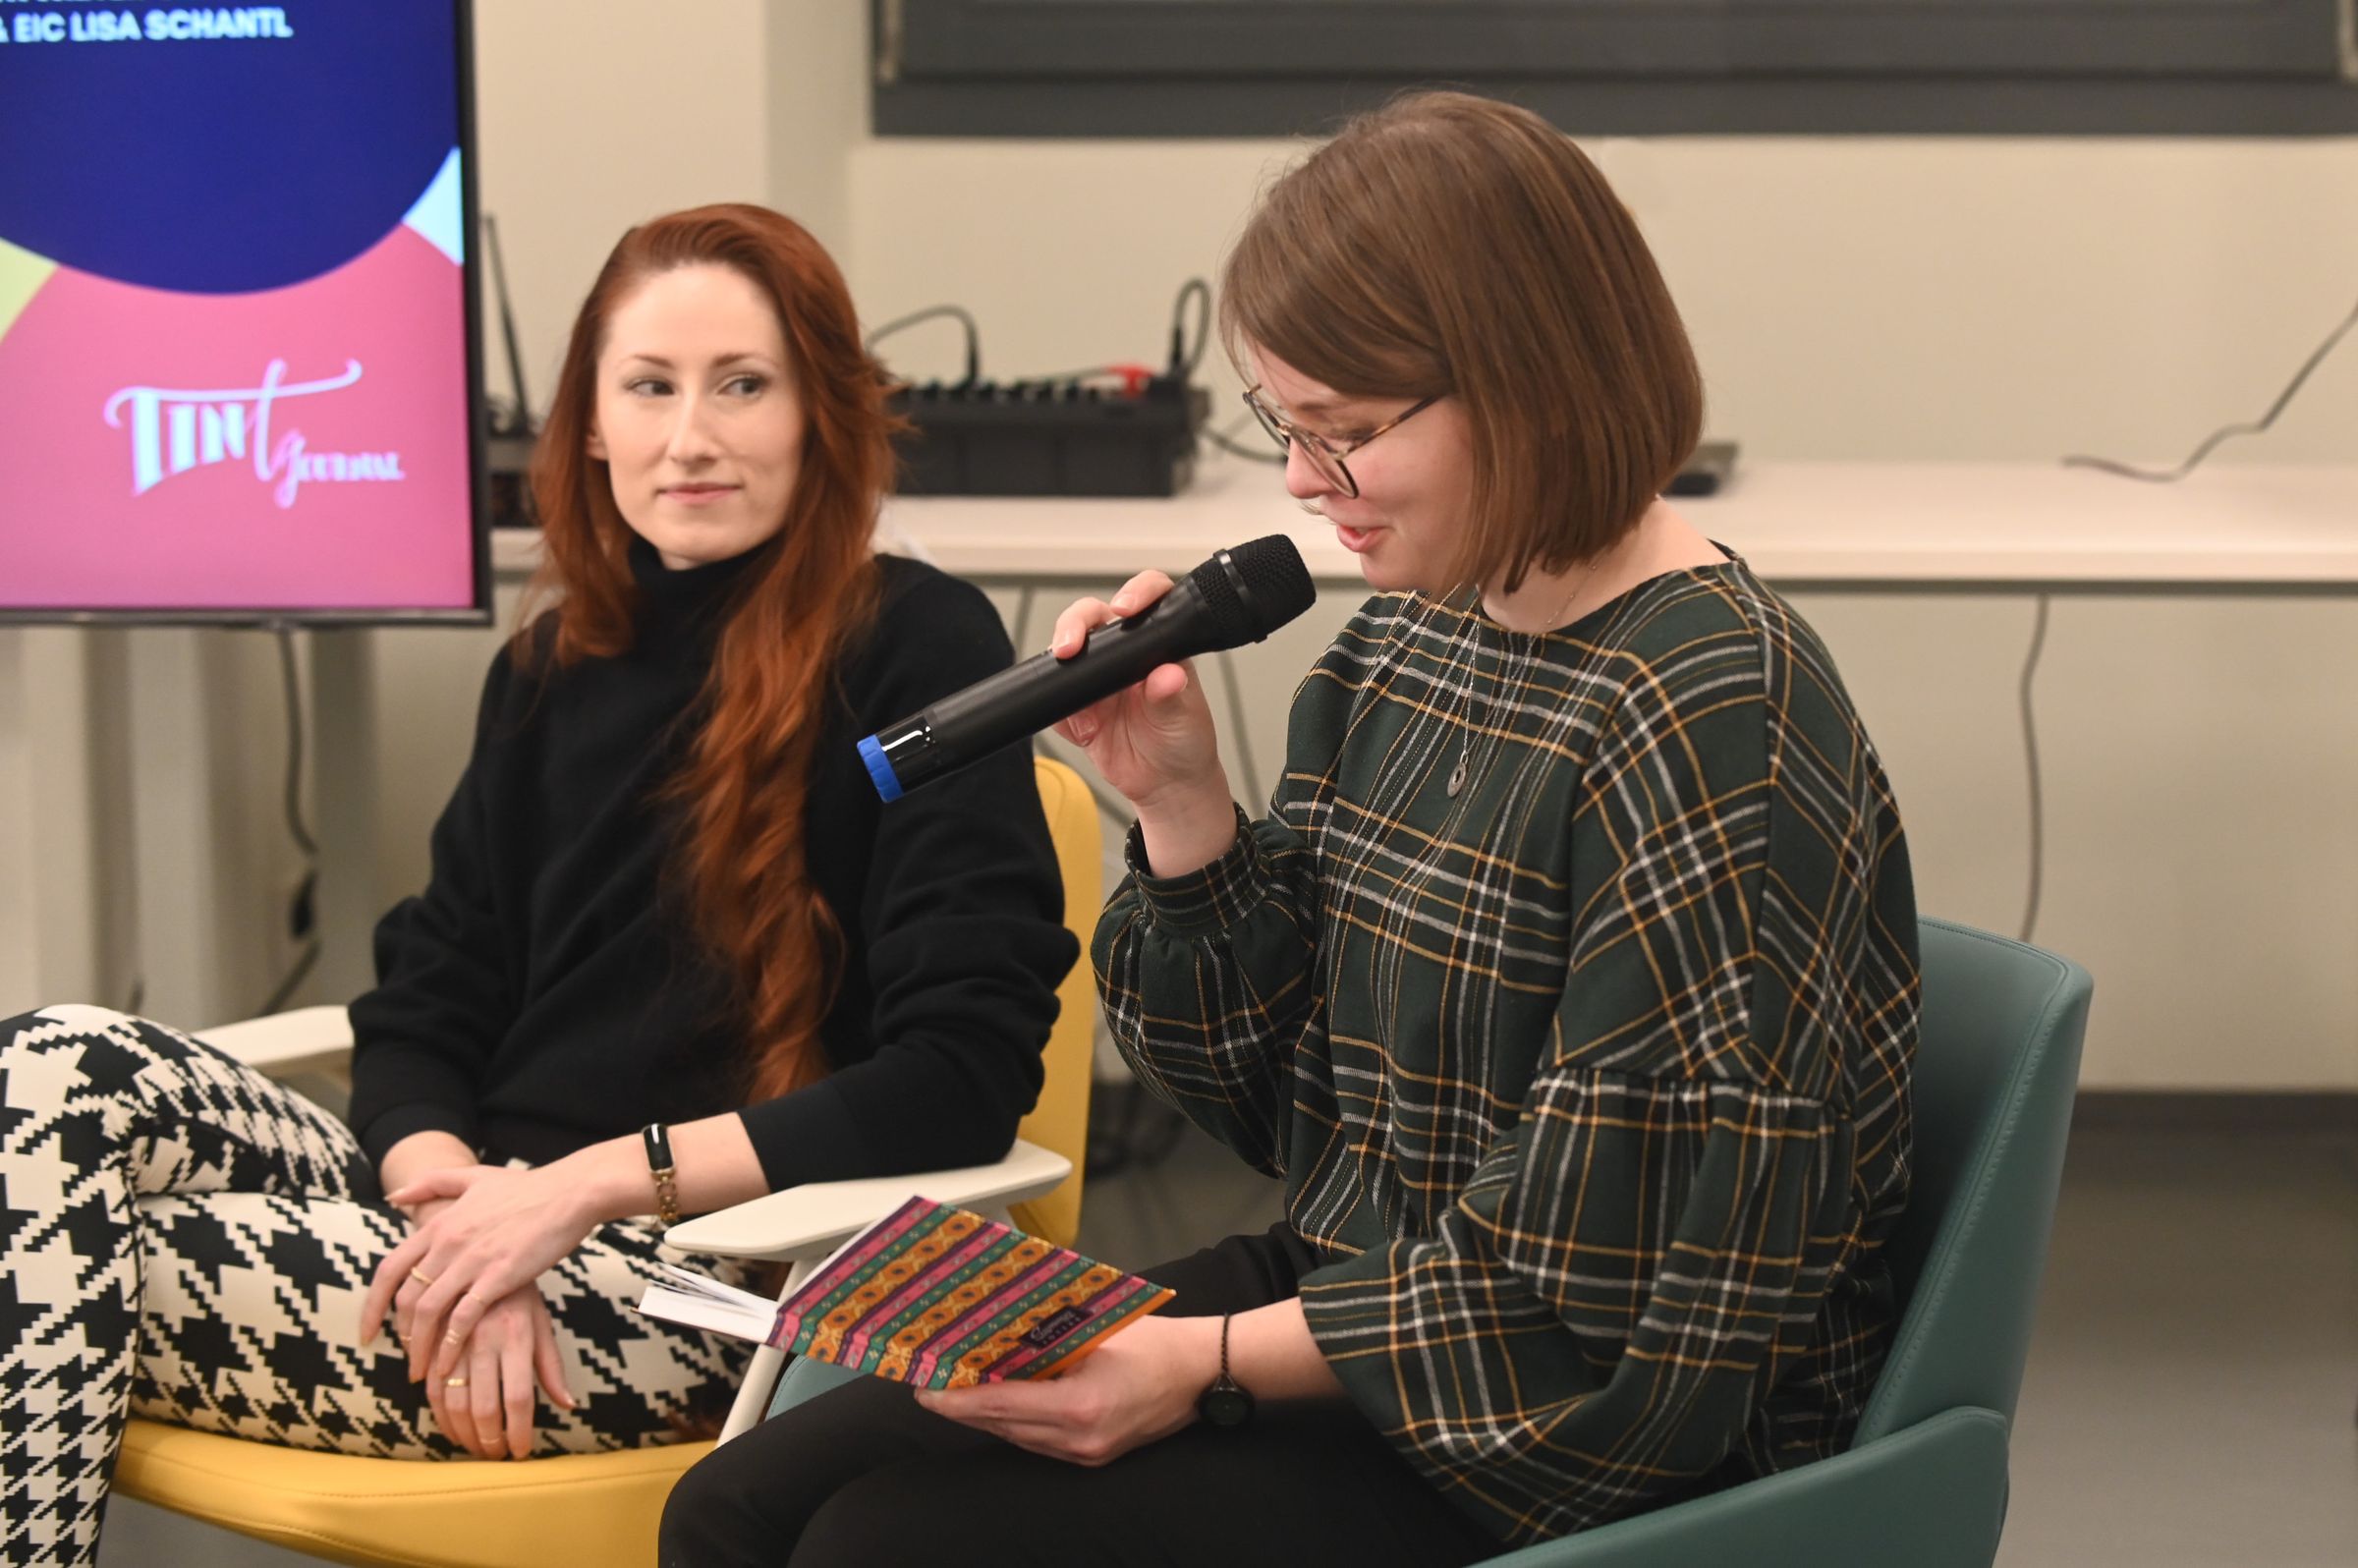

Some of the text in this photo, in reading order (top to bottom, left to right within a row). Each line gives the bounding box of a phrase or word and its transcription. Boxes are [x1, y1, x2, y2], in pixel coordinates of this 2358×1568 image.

[14, 12, 66, 42] EIC
[70, 11, 142, 41] LISA
[144, 7, 294, 40] SCHANTL
